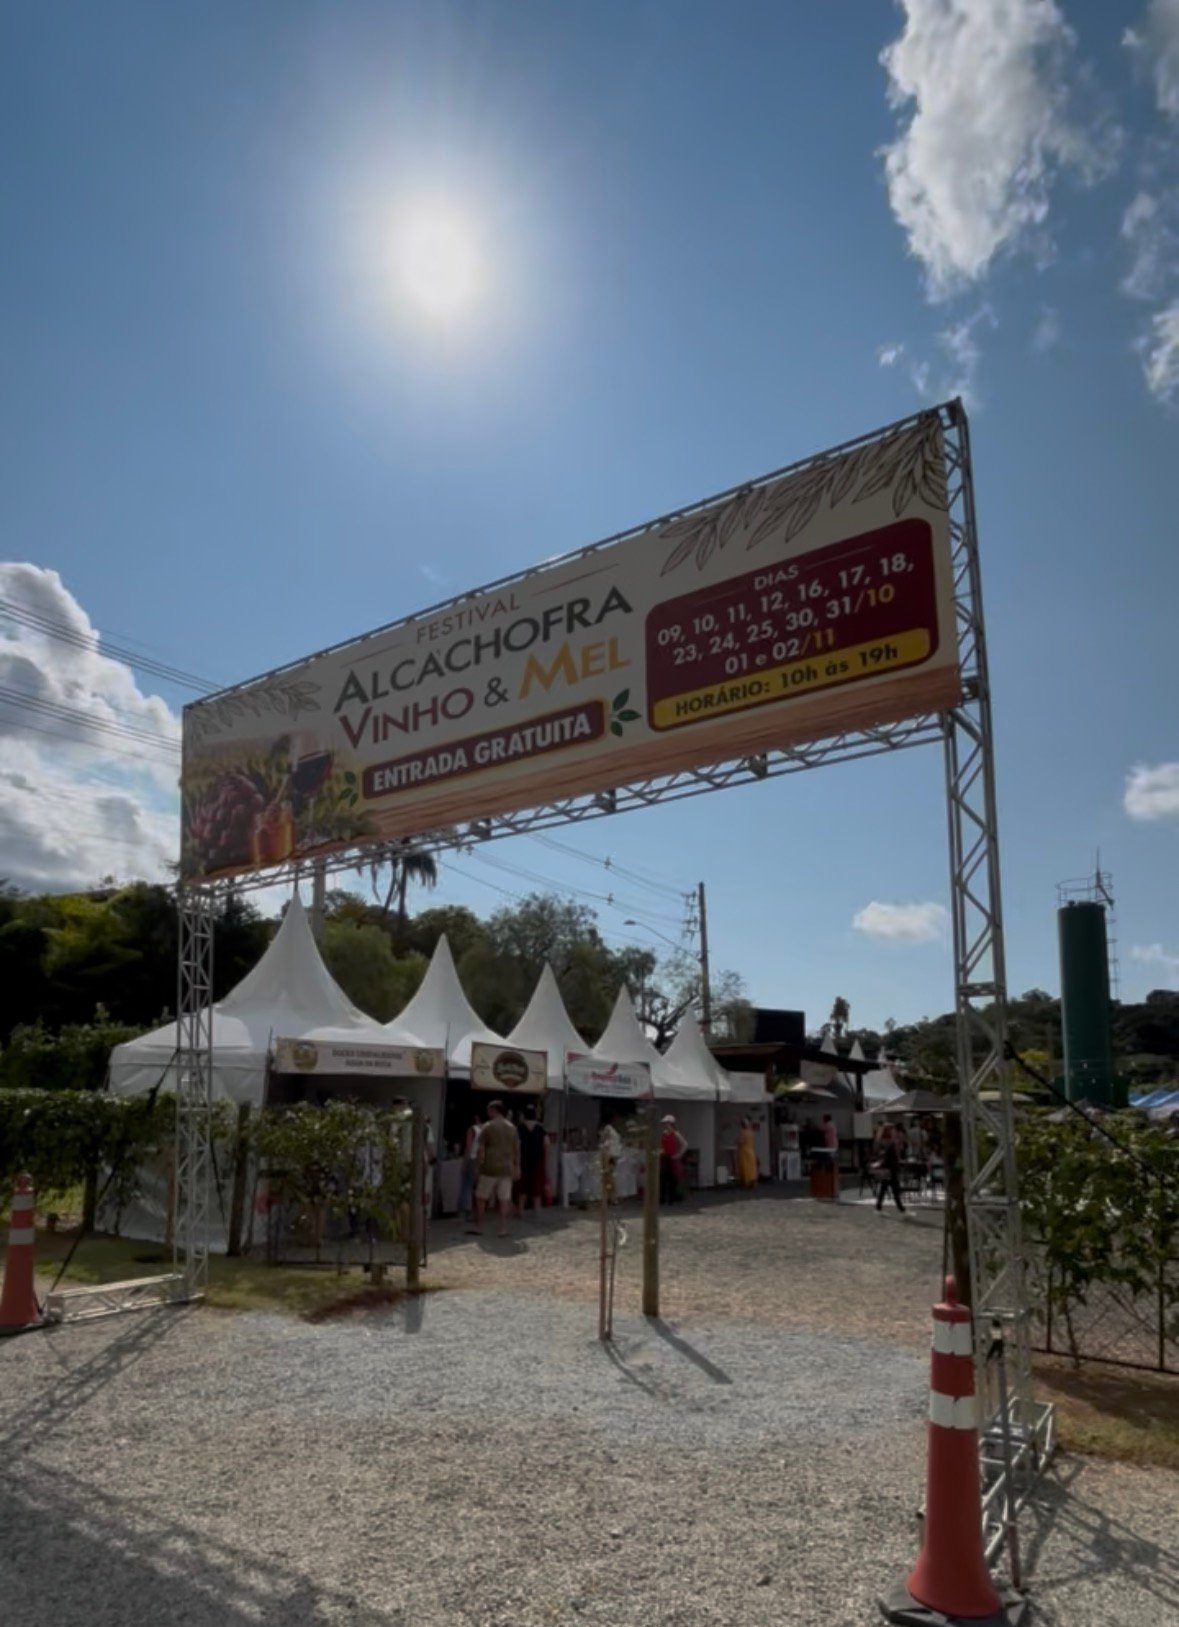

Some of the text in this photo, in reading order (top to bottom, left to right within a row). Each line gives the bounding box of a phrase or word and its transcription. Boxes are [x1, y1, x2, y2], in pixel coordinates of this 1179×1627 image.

[657, 553, 915, 646] 09, 10, 11, 12, 16, 17, 18,
[754, 565, 799, 590] DIAS
[333, 585, 634, 714] ALCACHOFRA
[416, 593, 520, 645] FESTIVAL
[673, 645, 702, 666] 23,
[709, 632, 740, 653] 24,
[747, 620, 778, 643] 25,
[785, 608, 819, 631] 30,
[338, 636, 632, 749] VINHO & MEL
[675, 678, 771, 717] HORÁRIO:
[781, 664, 818, 689] 10h
[859, 644, 898, 667] 19h
[725, 653, 748, 674] 01
[755, 653, 767, 666] e
[373, 712, 591, 792] ENTRADA GRATUITA
